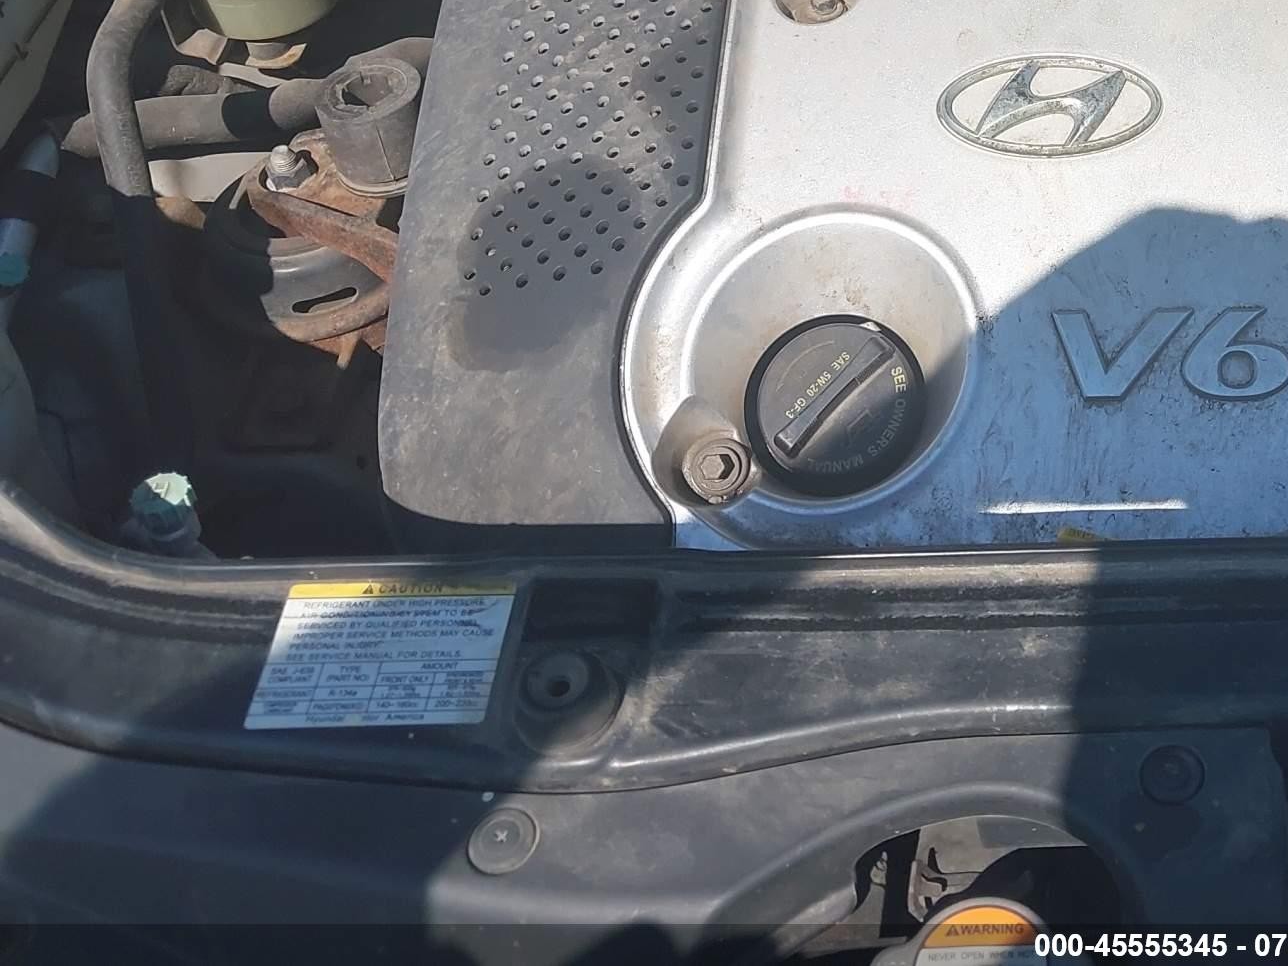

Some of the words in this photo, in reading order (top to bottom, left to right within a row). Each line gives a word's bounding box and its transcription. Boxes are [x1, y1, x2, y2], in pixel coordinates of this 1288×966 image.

[831, 351, 851, 371] SAE
[806, 371, 832, 397] 5W-20
[891, 366, 907, 393] SEE
[785, 399, 807, 419] GF-3
[867, 399, 907, 457] OWNER'S
[807, 455, 864, 473] MANUAL
[379, 584, 443, 594] CAUTION
[304, 600, 370, 609] REFRIGERANT
[373, 599, 408, 608] UNDER
[409, 599, 432, 607] HIGH
[350, 621, 364, 629] BY
[366, 620, 417, 628] QUALIFIED
[293, 632, 343, 640] IMPROPER
[346, 631, 386, 639] SERVICE
[439, 629, 459, 637] MAY
[289, 642, 340, 650] PERSONAL
[351, 651, 394, 660] MANUAL
[397, 650, 419, 659] FOR
[340, 665, 361, 674] TYPE
[421, 661, 459, 670] AMOUNT
[960, 923, 1025, 935] WARNING
[928, 952, 956, 962] NEVER
[960, 951, 985, 959] OPEN
